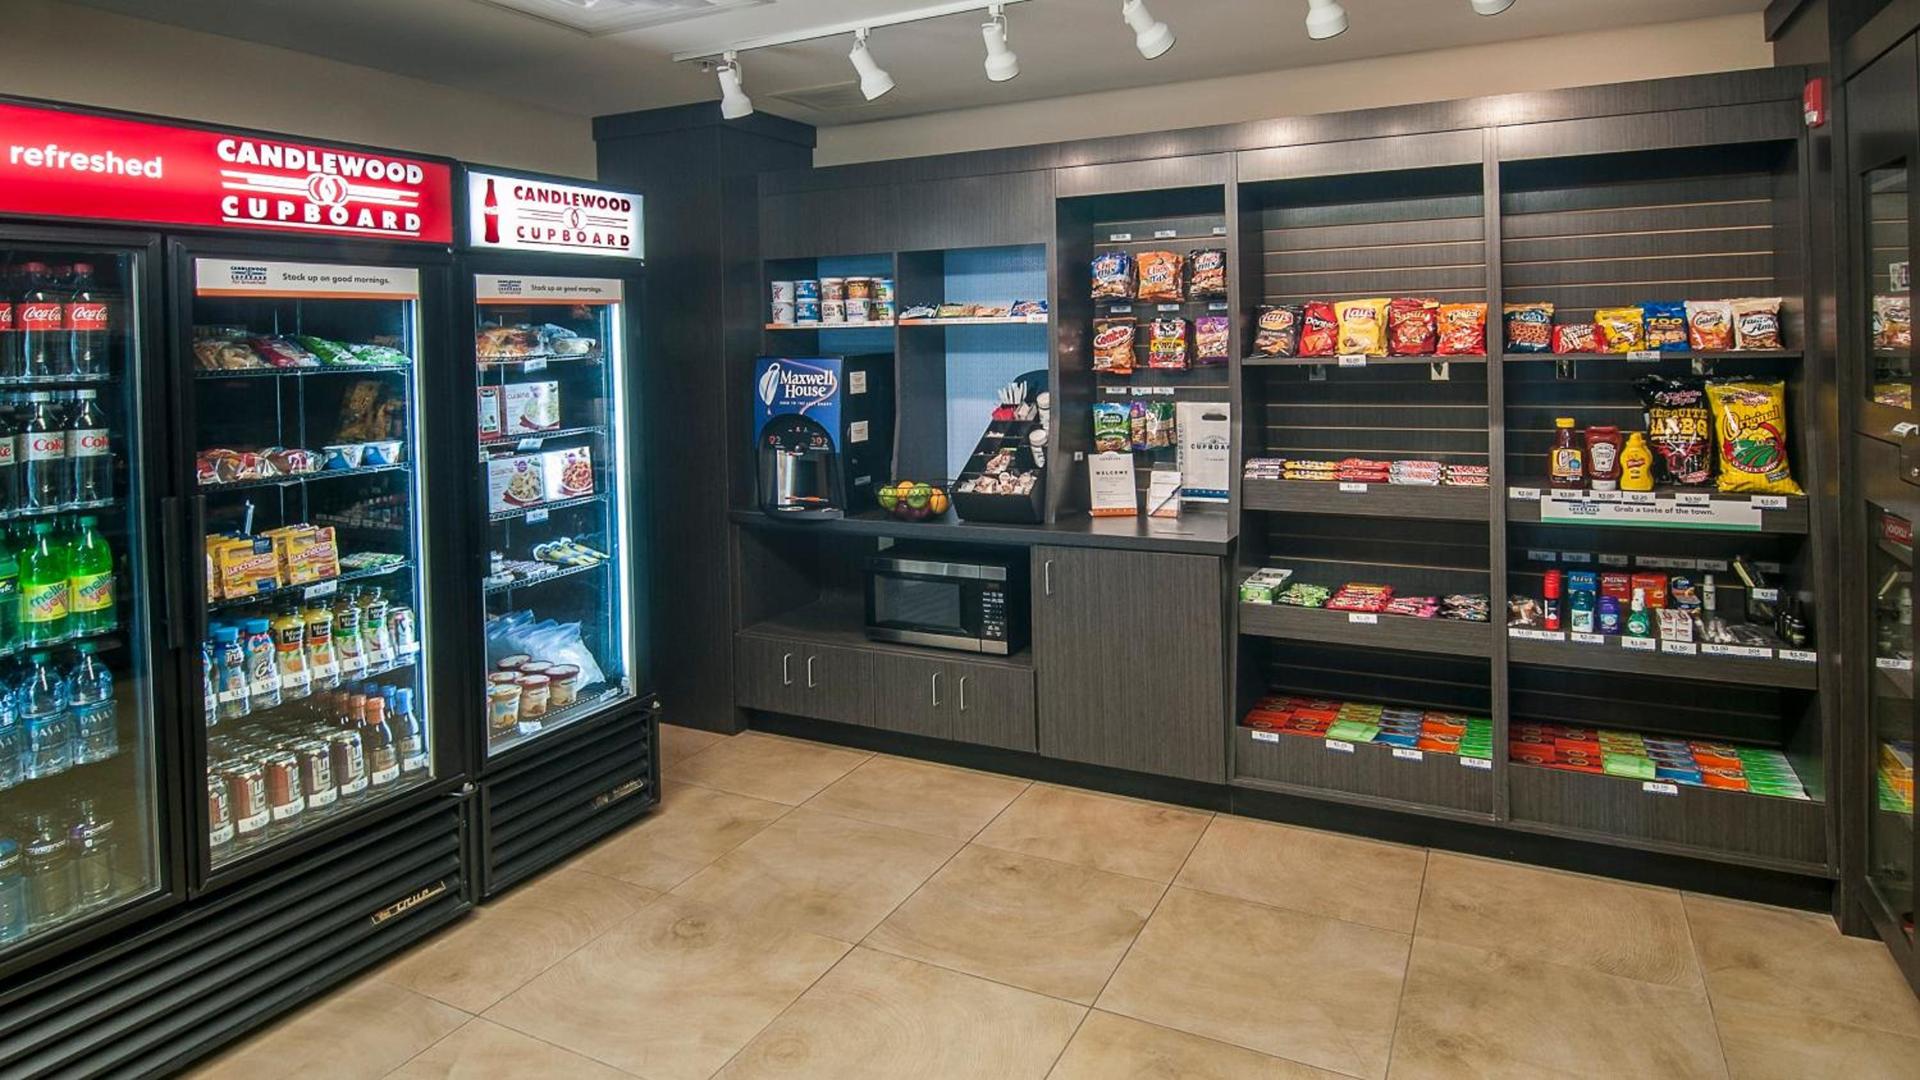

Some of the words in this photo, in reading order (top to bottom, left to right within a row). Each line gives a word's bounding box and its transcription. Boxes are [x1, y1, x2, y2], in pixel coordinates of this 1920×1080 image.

[9, 144, 163, 179] refreshed
[217, 139, 424, 184] CANDLEWOOD
[514, 186, 631, 213] CANDLEWOOD
[221, 196, 421, 231] CUPBOARD
[517, 226, 630, 247] CUPBOARD
[282, 273, 305, 281] Stock
[332, 274, 352, 283] good
[354, 276, 389, 286] mornings.
[780, 369, 833, 385] Maxwell
[784, 384, 826, 398] House
[1724, 405, 1780, 440] Original
[1614, 505, 1633, 513] Grab
